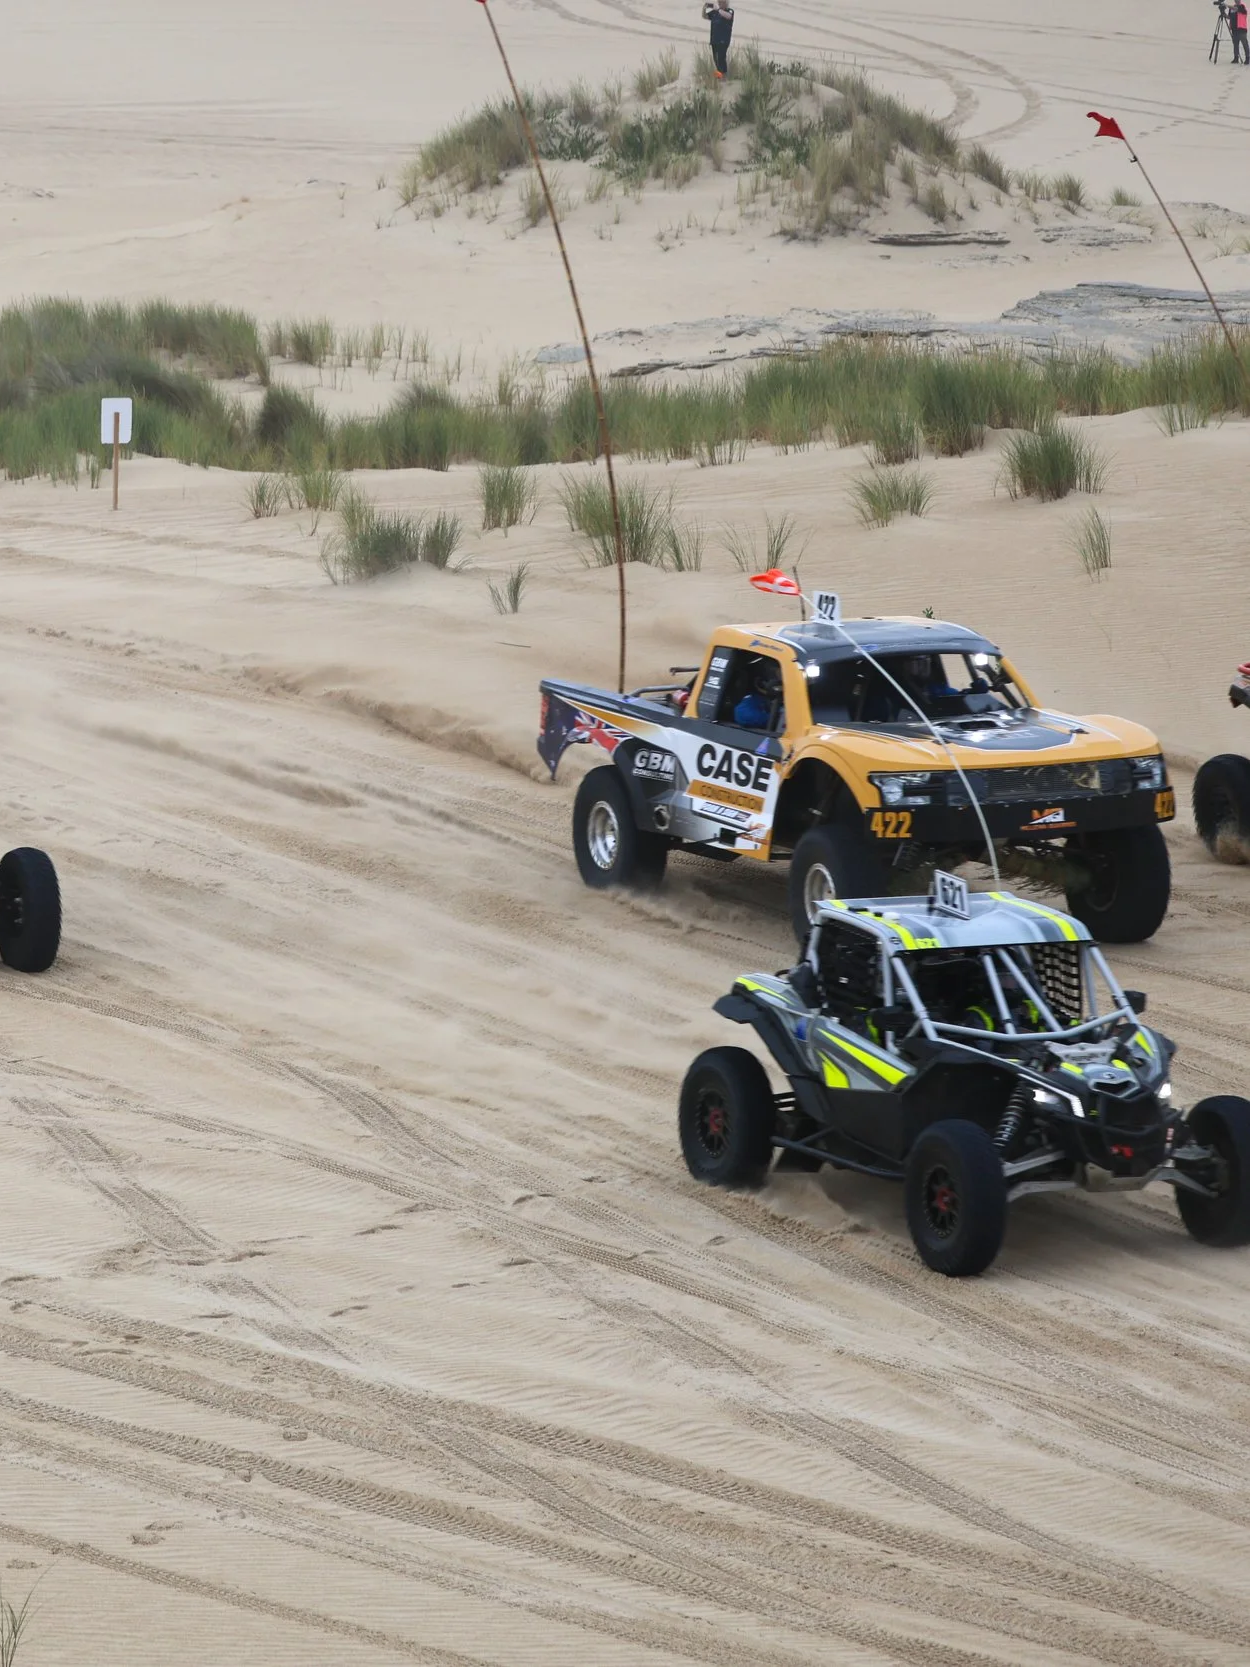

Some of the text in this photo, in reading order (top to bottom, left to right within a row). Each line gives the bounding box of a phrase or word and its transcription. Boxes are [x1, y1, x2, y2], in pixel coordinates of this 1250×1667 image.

[634, 750, 676, 773] GBM
[696, 743, 775, 793] CASE
[700, 784, 763, 811] CONSTRUCTION
[871, 811, 912, 838] 422
[940, 876, 965, 912] 621
